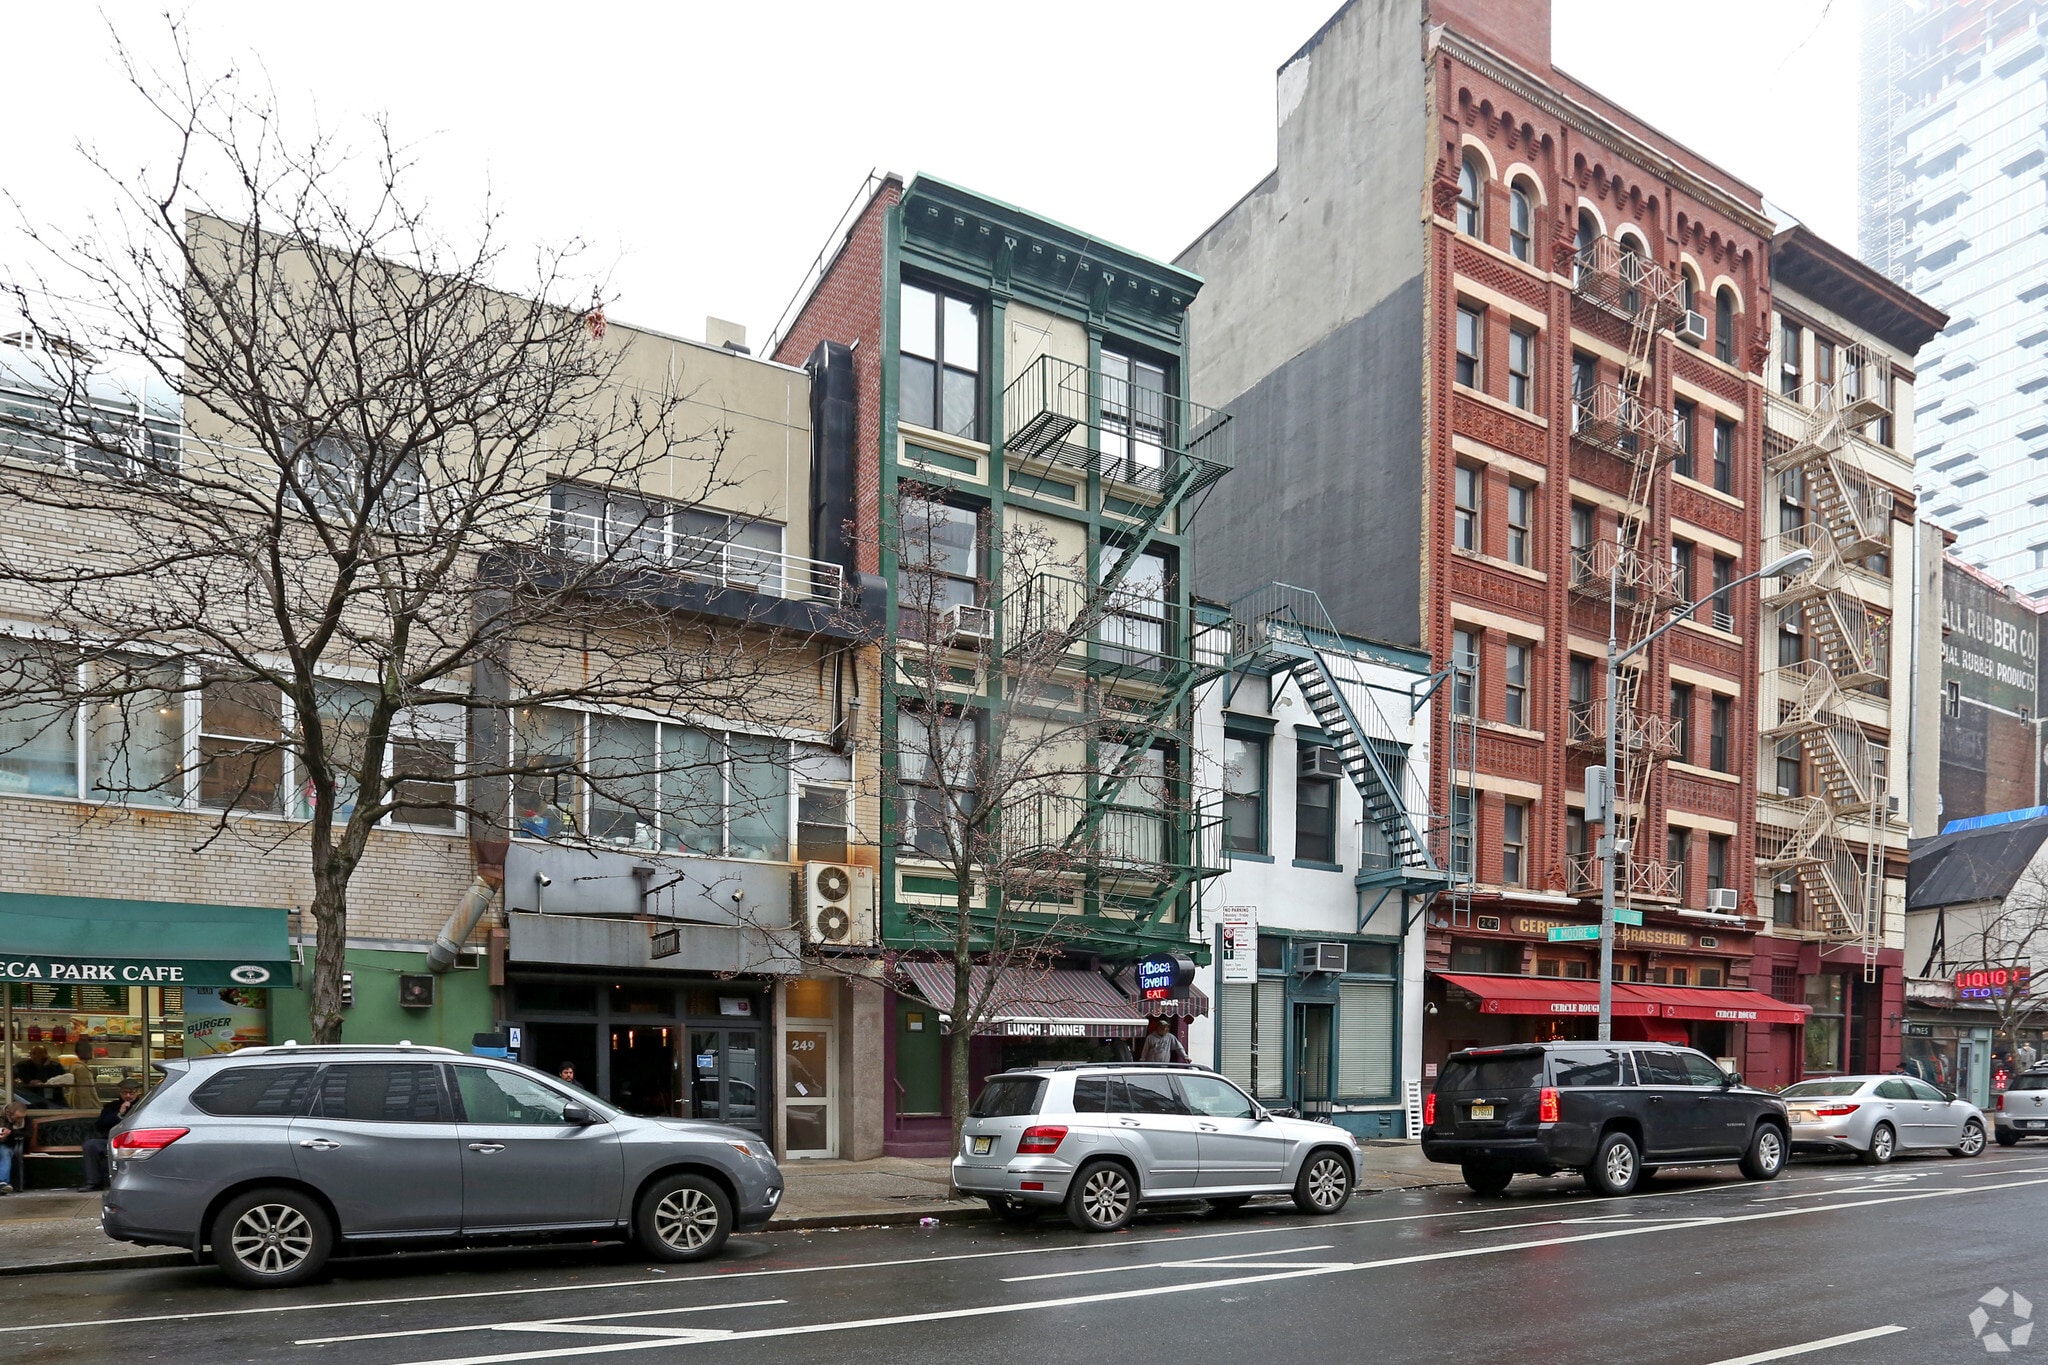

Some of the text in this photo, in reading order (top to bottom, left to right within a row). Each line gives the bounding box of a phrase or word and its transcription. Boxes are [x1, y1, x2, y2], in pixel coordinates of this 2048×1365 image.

[1967, 608, 2018, 653] RUBBER
[2020, 629, 2036, 661] CO.
[1962, 650, 1994, 679] RUBBER
[1997, 662, 2035, 692] PRODUCTS
[1562, 928, 1588, 939] MOORE
[1622, 928, 1687, 946] BRASSERIE
[50, 963, 116, 980] PARK
[122, 965, 184, 982] CAFE
[1137, 961, 1171, 975] Tribeca
[1140, 976, 1170, 989] Tavern
[1146, 989, 1165, 999] EAT
[1550, 1003, 1577, 1013] CERCLE
[1715, 1009, 1757, 1020] CERCLE ROUGE
[187, 1017, 232, 1035] BURGER
[1007, 1023, 1086, 1036] LUNCH DINNER
[193, 1028, 213, 1039] MAX
[512, 1030, 519, 1042] A
[792, 1040, 815, 1051] 249
